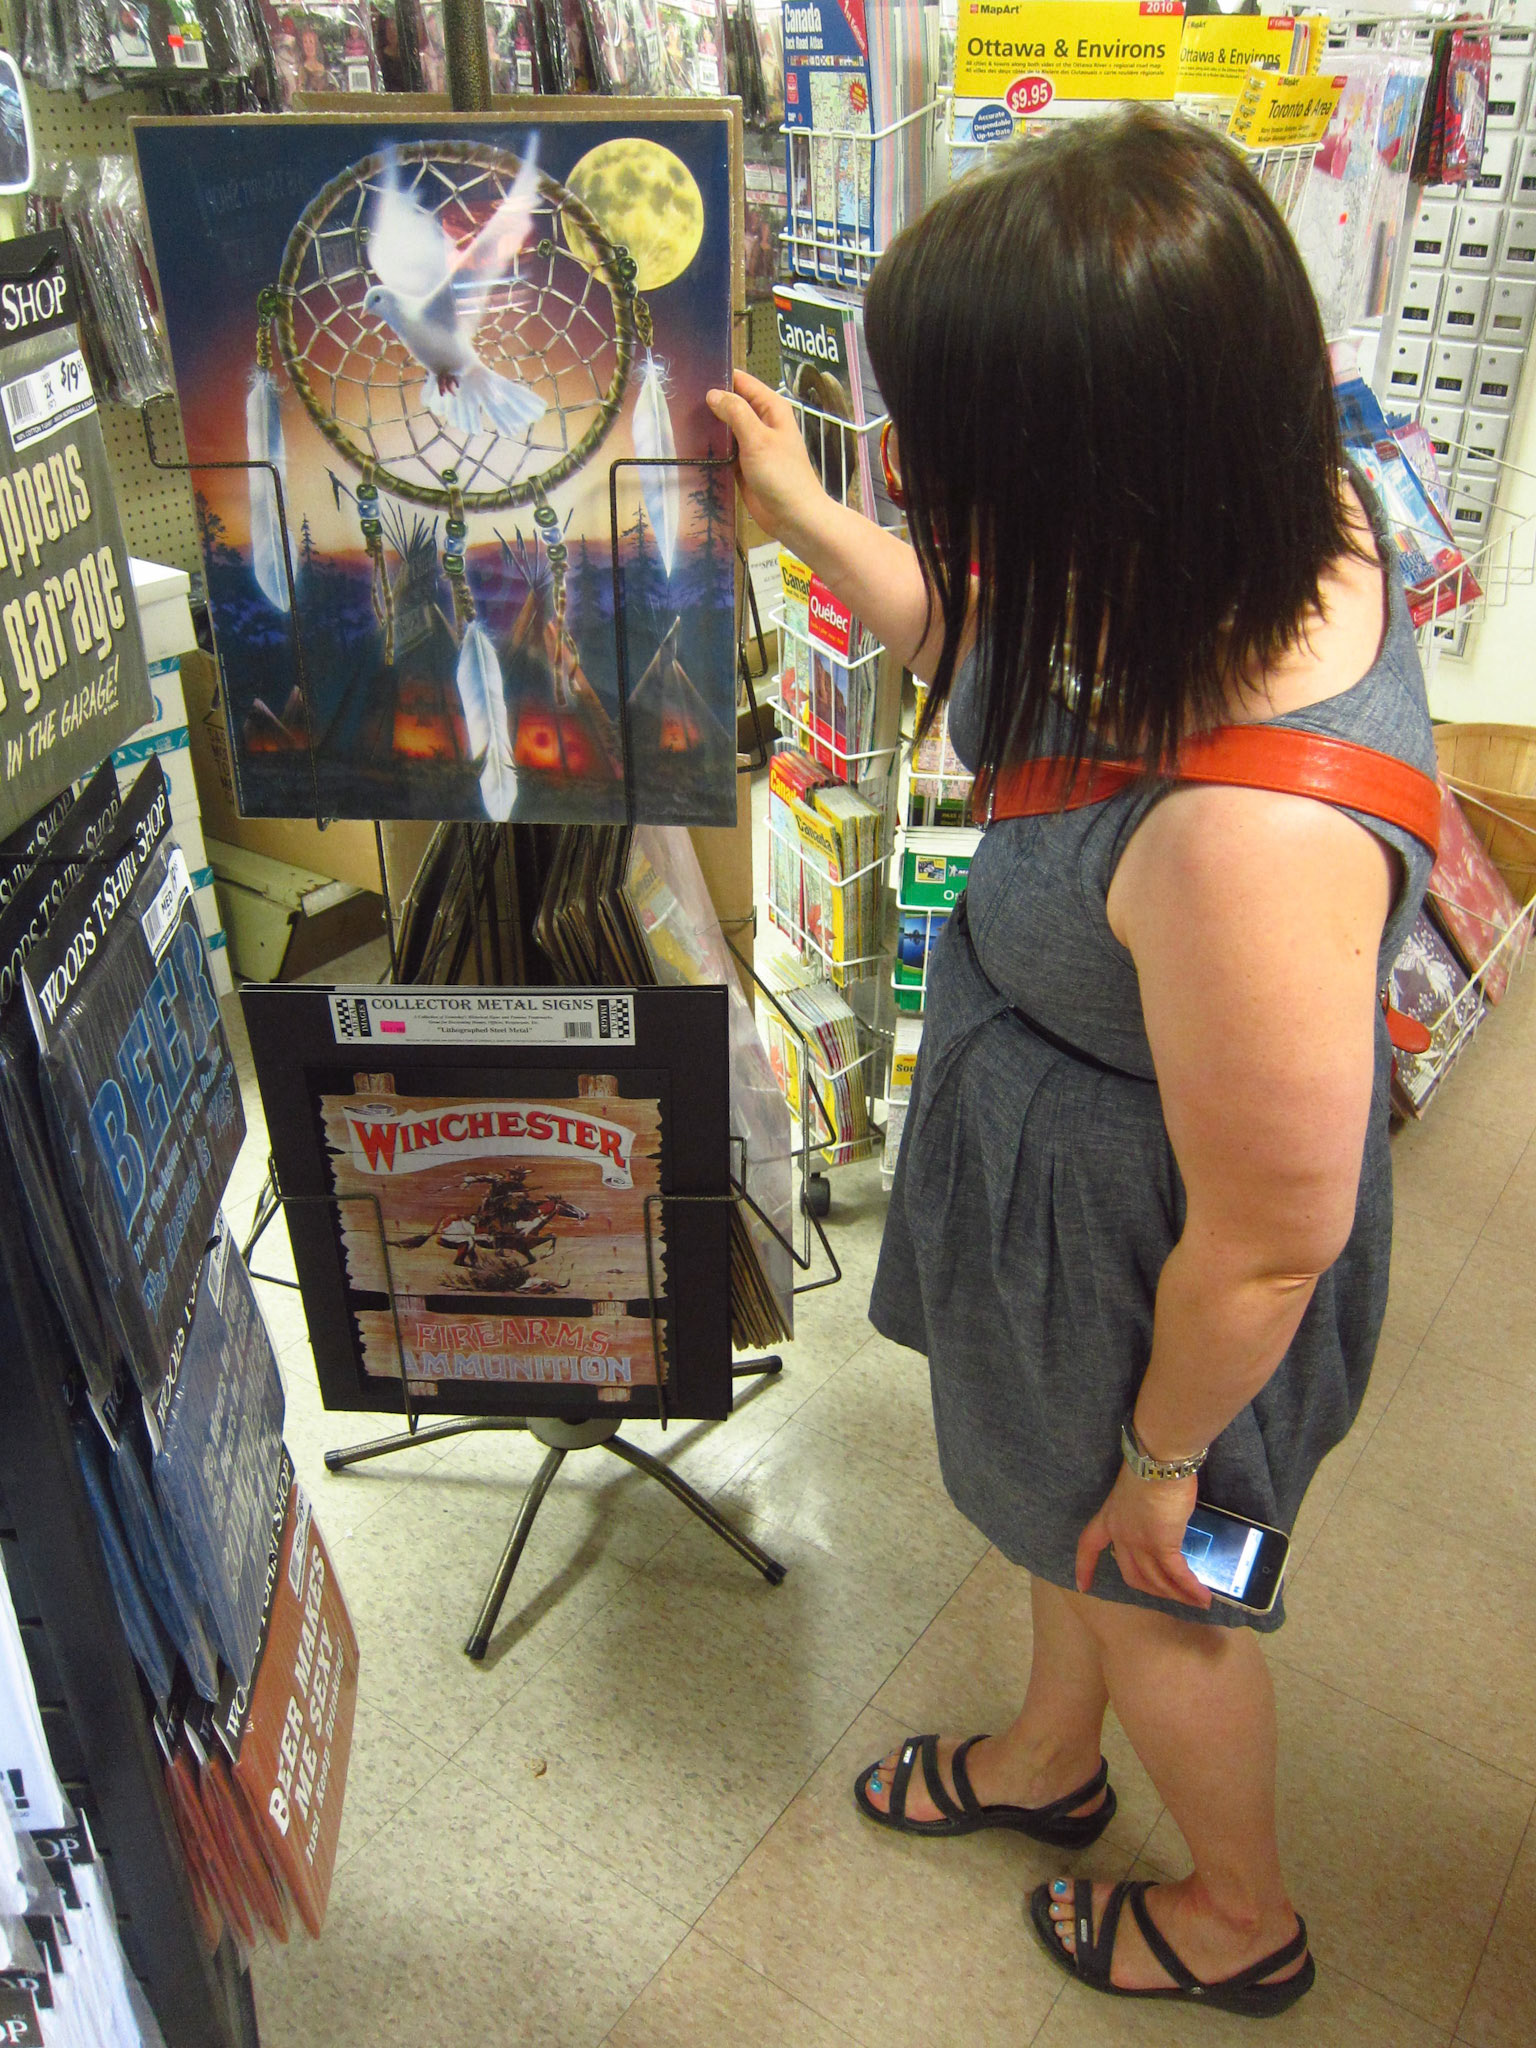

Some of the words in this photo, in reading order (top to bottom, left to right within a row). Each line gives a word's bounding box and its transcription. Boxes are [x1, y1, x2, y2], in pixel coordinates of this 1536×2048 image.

[785, 2, 822, 33] Canada
[980, 4, 1020, 15] MapArt
[1146, 1, 1173, 14] 2010
[967, 37, 1045, 58] Ottawa
[1054, 39, 1068, 58] &
[1077, 39, 1166, 59] Environs
[1179, 47, 1215, 62] Ottawa
[1217, 48, 1226, 64] &
[1229, 48, 1281, 66] Environs
[1011, 82, 1049, 112] $9.95
[1268, 99, 1303, 119] Toronto
[1304, 100, 1311, 118] &
[1312, 97, 1333, 116] Area
[974, 119, 1011, 132] Dependable
[977, 110, 1005, 121] Accurate
[976, 128, 1011, 141] Up-to-Date
[1, 276, 67, 331] SHOP
[776, 312, 840, 364] Canada
[0, 443, 92, 577] ppens
[3, 546, 126, 715] garage
[810, 595, 849, 634] Québec
[28, 707, 57, 762] THE
[61, 653, 121, 739] GARAGE!
[39, 916, 98, 1025] WOODS
[134, 793, 166, 863] SHOP
[371, 998, 472, 1011] COLLECTOR
[477, 999, 538, 1011] METAL
[542, 999, 594, 1011] SIGNS
[610, 1003, 618, 1034] METAL
[88, 921, 220, 1240] BEER
[350, 1110, 627, 1172] WINCHESTER
[415, 1317, 612, 1356] FIREARMS
[402, 1351, 632, 1383] AMMUNITION
[268, 1695, 305, 1837] BEER
[294, 1543, 326, 1700] MAKES
[294, 1731, 319, 1824] ME
[309, 1616, 335, 1738] SEXY
[306, 1808, 322, 1866] Just
[315, 1744, 332, 1809] Keep
[325, 1635, 345, 1744] Drinking!
